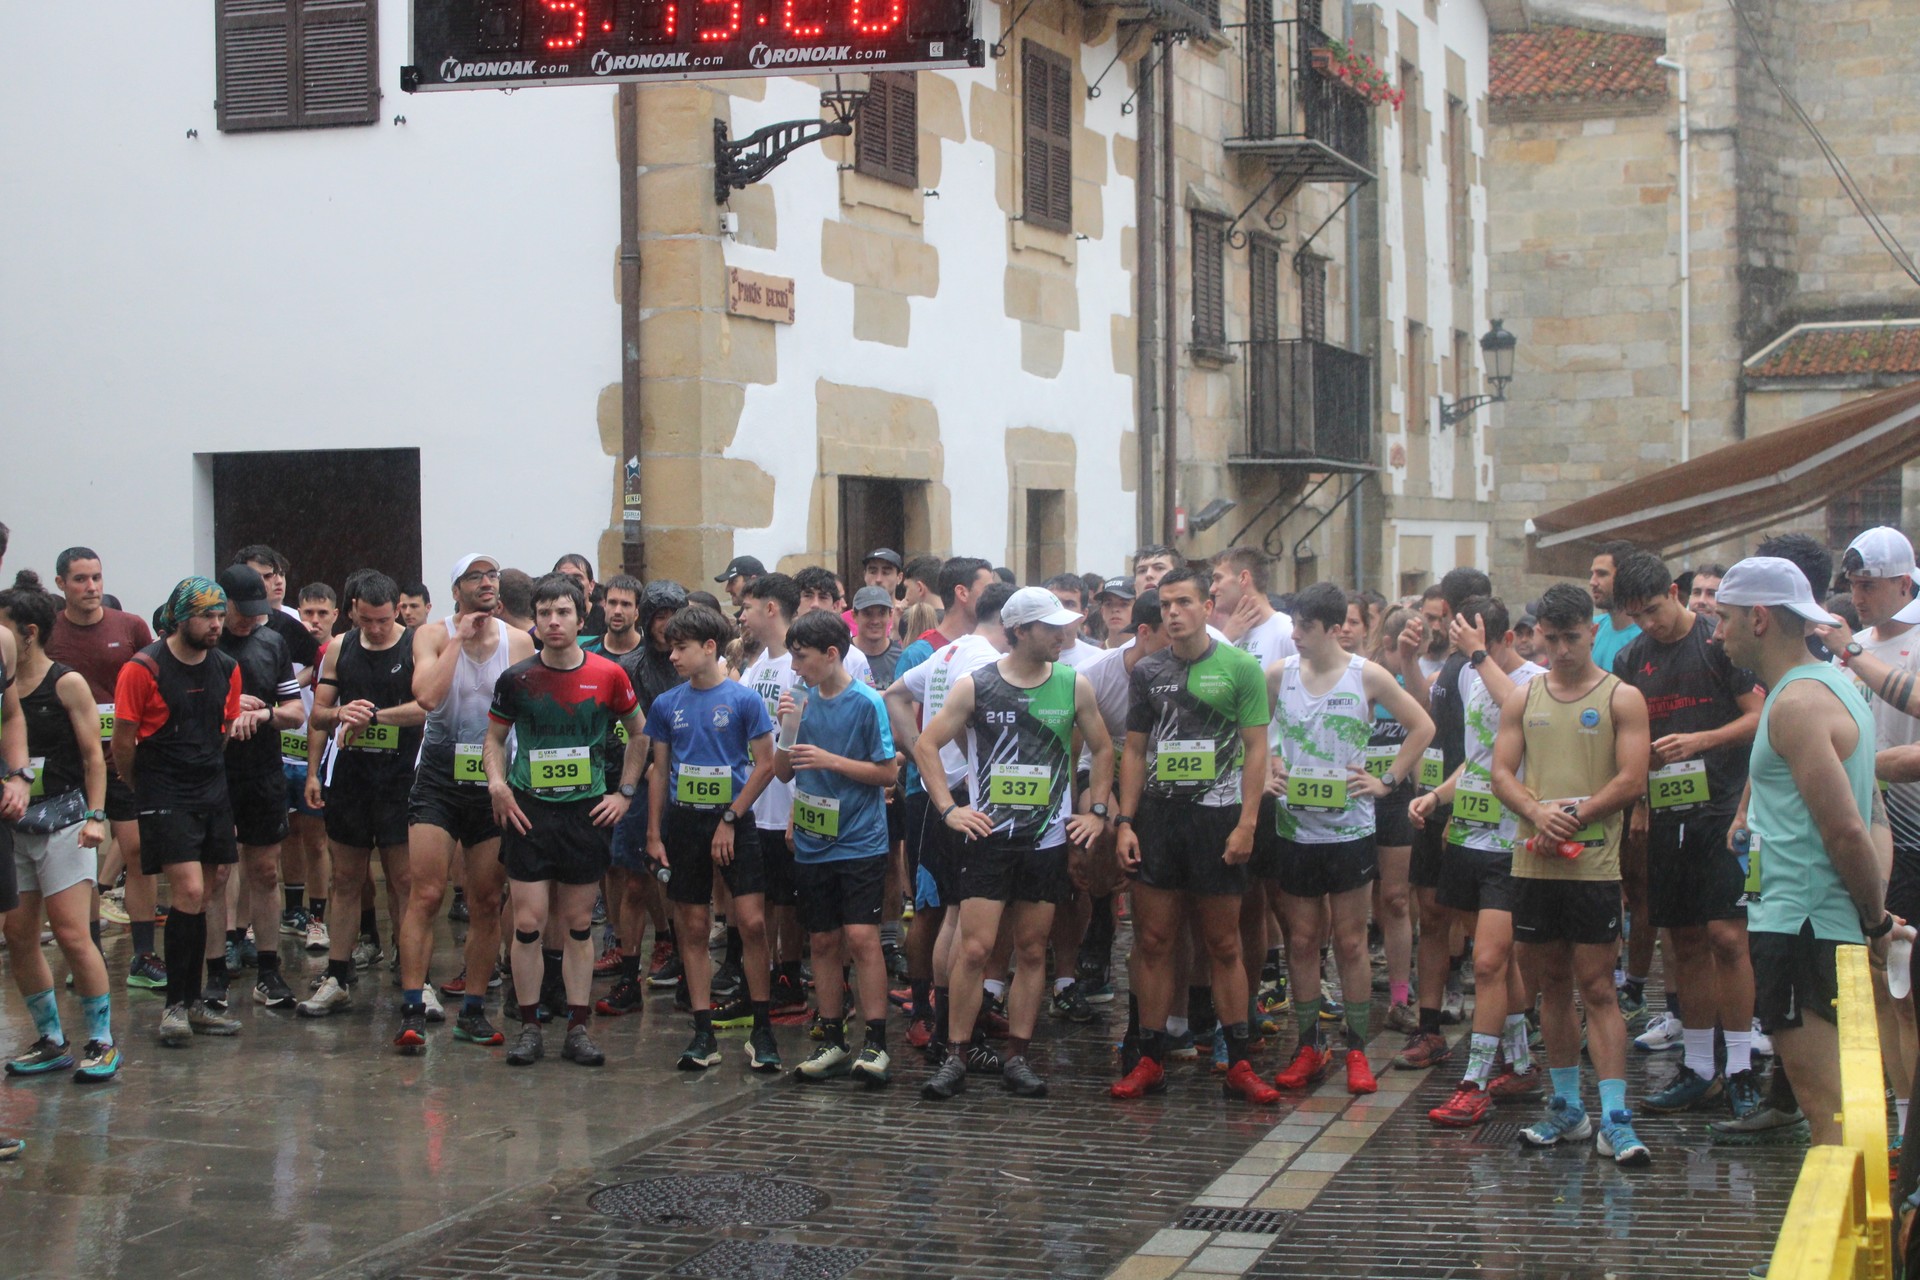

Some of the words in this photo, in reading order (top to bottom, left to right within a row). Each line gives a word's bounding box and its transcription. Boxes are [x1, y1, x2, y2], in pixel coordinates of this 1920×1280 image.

[1150, 684, 1178, 694] 1775
[986, 711, 1016, 724] 215
[542, 763, 578, 779] 339
[1167, 757, 1202, 772] 242
[1365, 759, 1393, 773] 215
[686, 781, 720, 796] 166
[1002, 781, 1039, 797] 337
[1297, 782, 1333, 798] 319
[1660, 779, 1695, 798] 233
[1461, 795, 1489, 813] 175
[800, 807, 825, 827] 191
